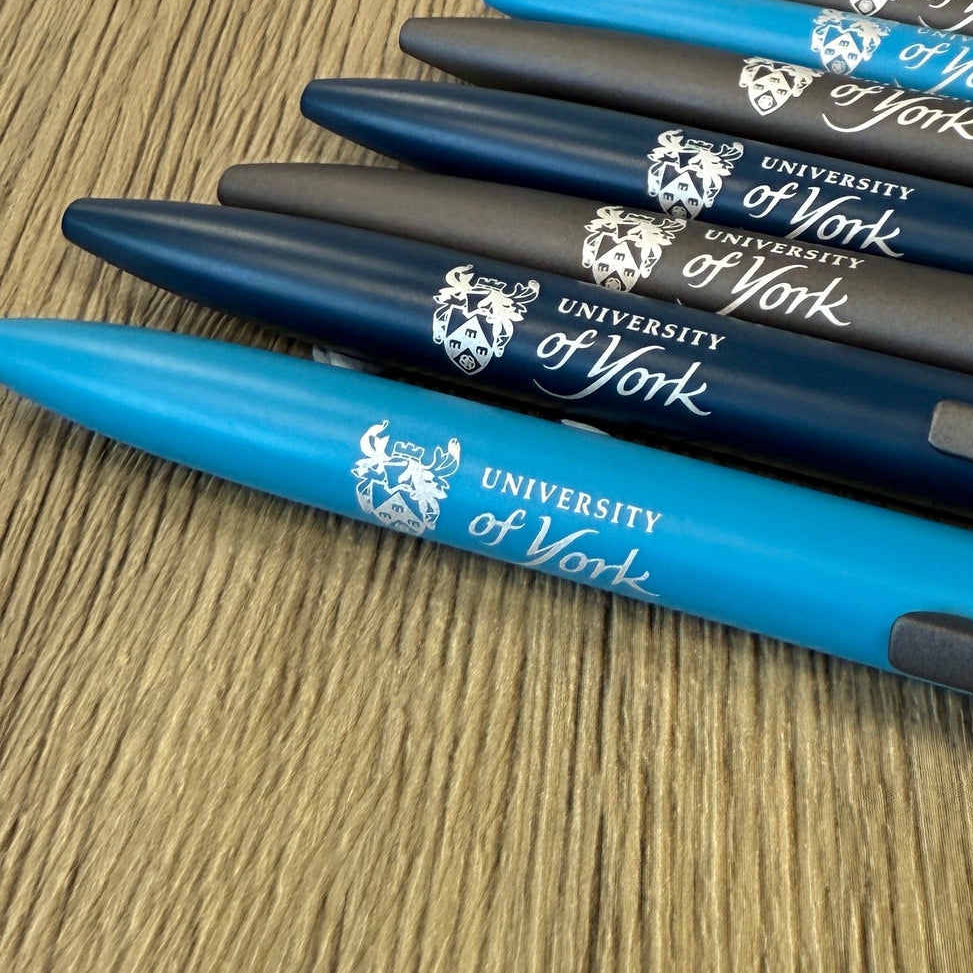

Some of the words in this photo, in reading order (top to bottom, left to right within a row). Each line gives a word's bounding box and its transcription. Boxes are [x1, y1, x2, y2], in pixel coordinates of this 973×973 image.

[899, 43, 950, 70] of
[830, 84, 886, 106] of
[761, 156, 916, 201] UNIVERSITY
[743, 181, 800, 219] of
[784, 187, 904, 258] York
[704, 229, 866, 270] UNIVERSITY
[682, 251, 744, 288] of
[715, 256, 852, 327] York
[535, 329, 599, 370] of
[557, 297, 728, 351] UNIVERSITY
[532, 334, 712, 416] York
[481, 467, 663, 534] UNIVERSITY
[468, 509, 527, 546] of
[521, 516, 661, 597] York
